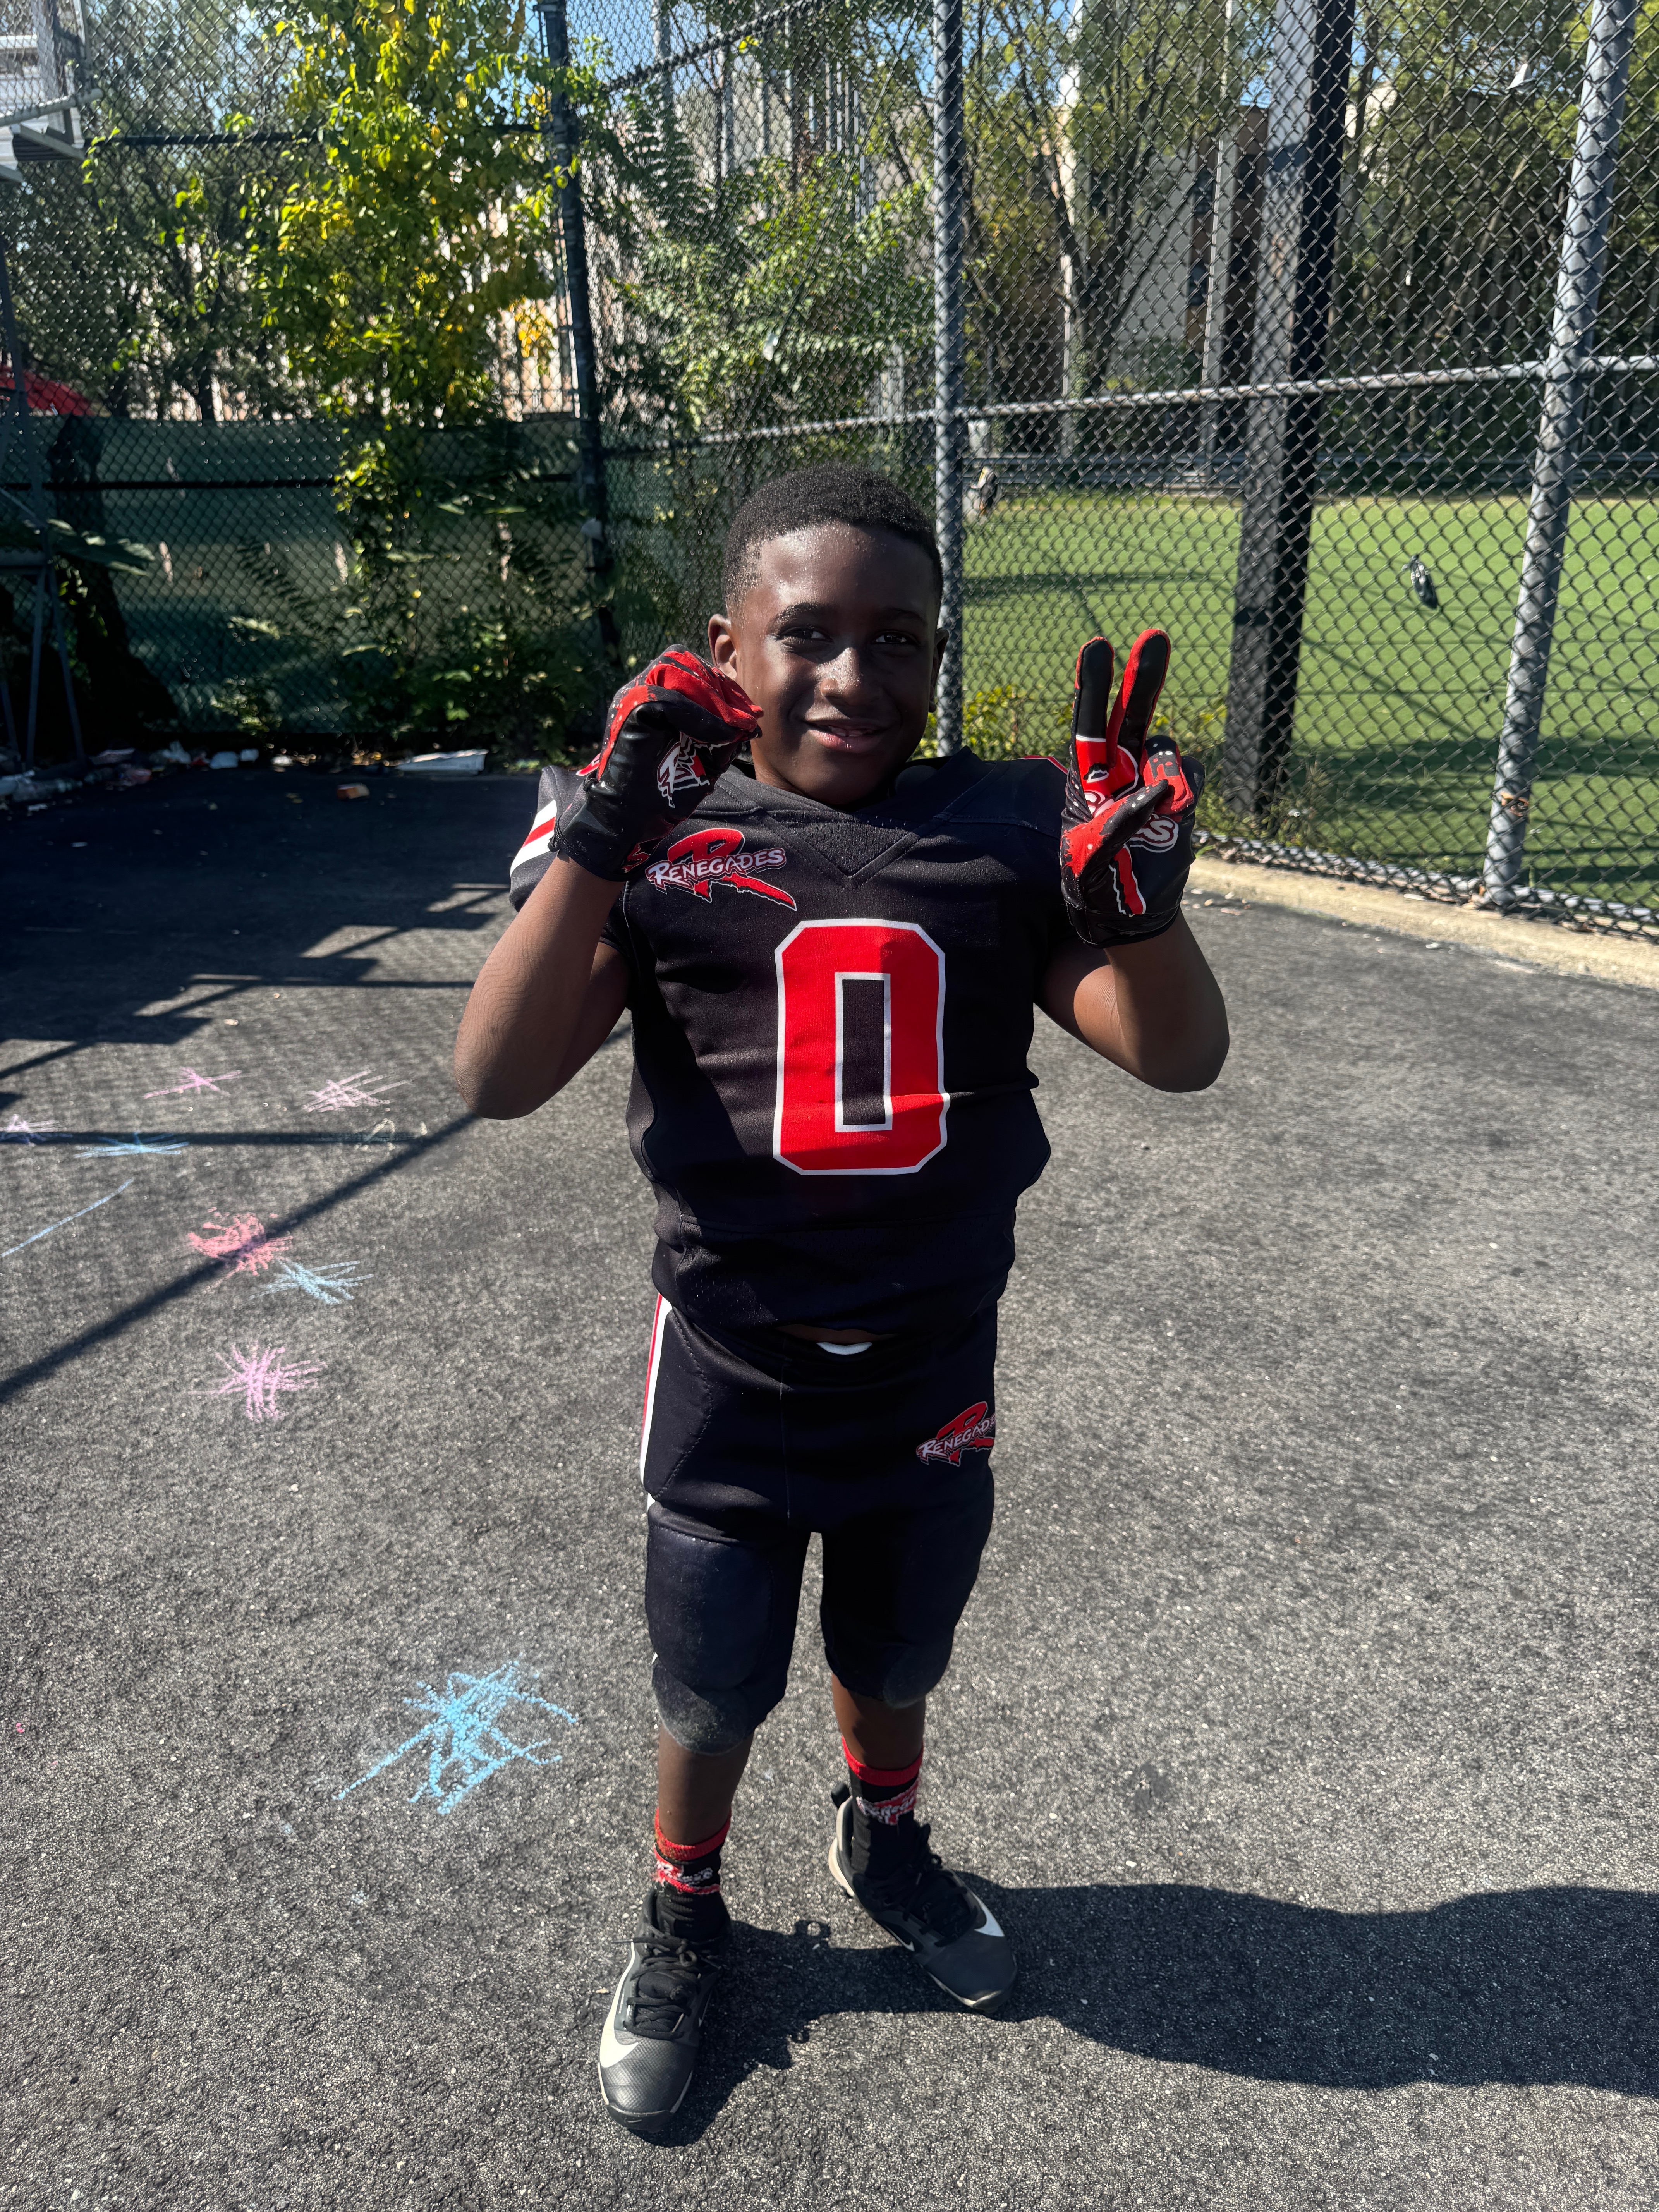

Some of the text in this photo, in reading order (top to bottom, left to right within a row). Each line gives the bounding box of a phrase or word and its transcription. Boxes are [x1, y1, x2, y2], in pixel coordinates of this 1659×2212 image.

[646, 848, 786, 891] RENEGADES
[773, 918, 951, 1175] 0
[916, 1414, 996, 1462] RENEGAD
